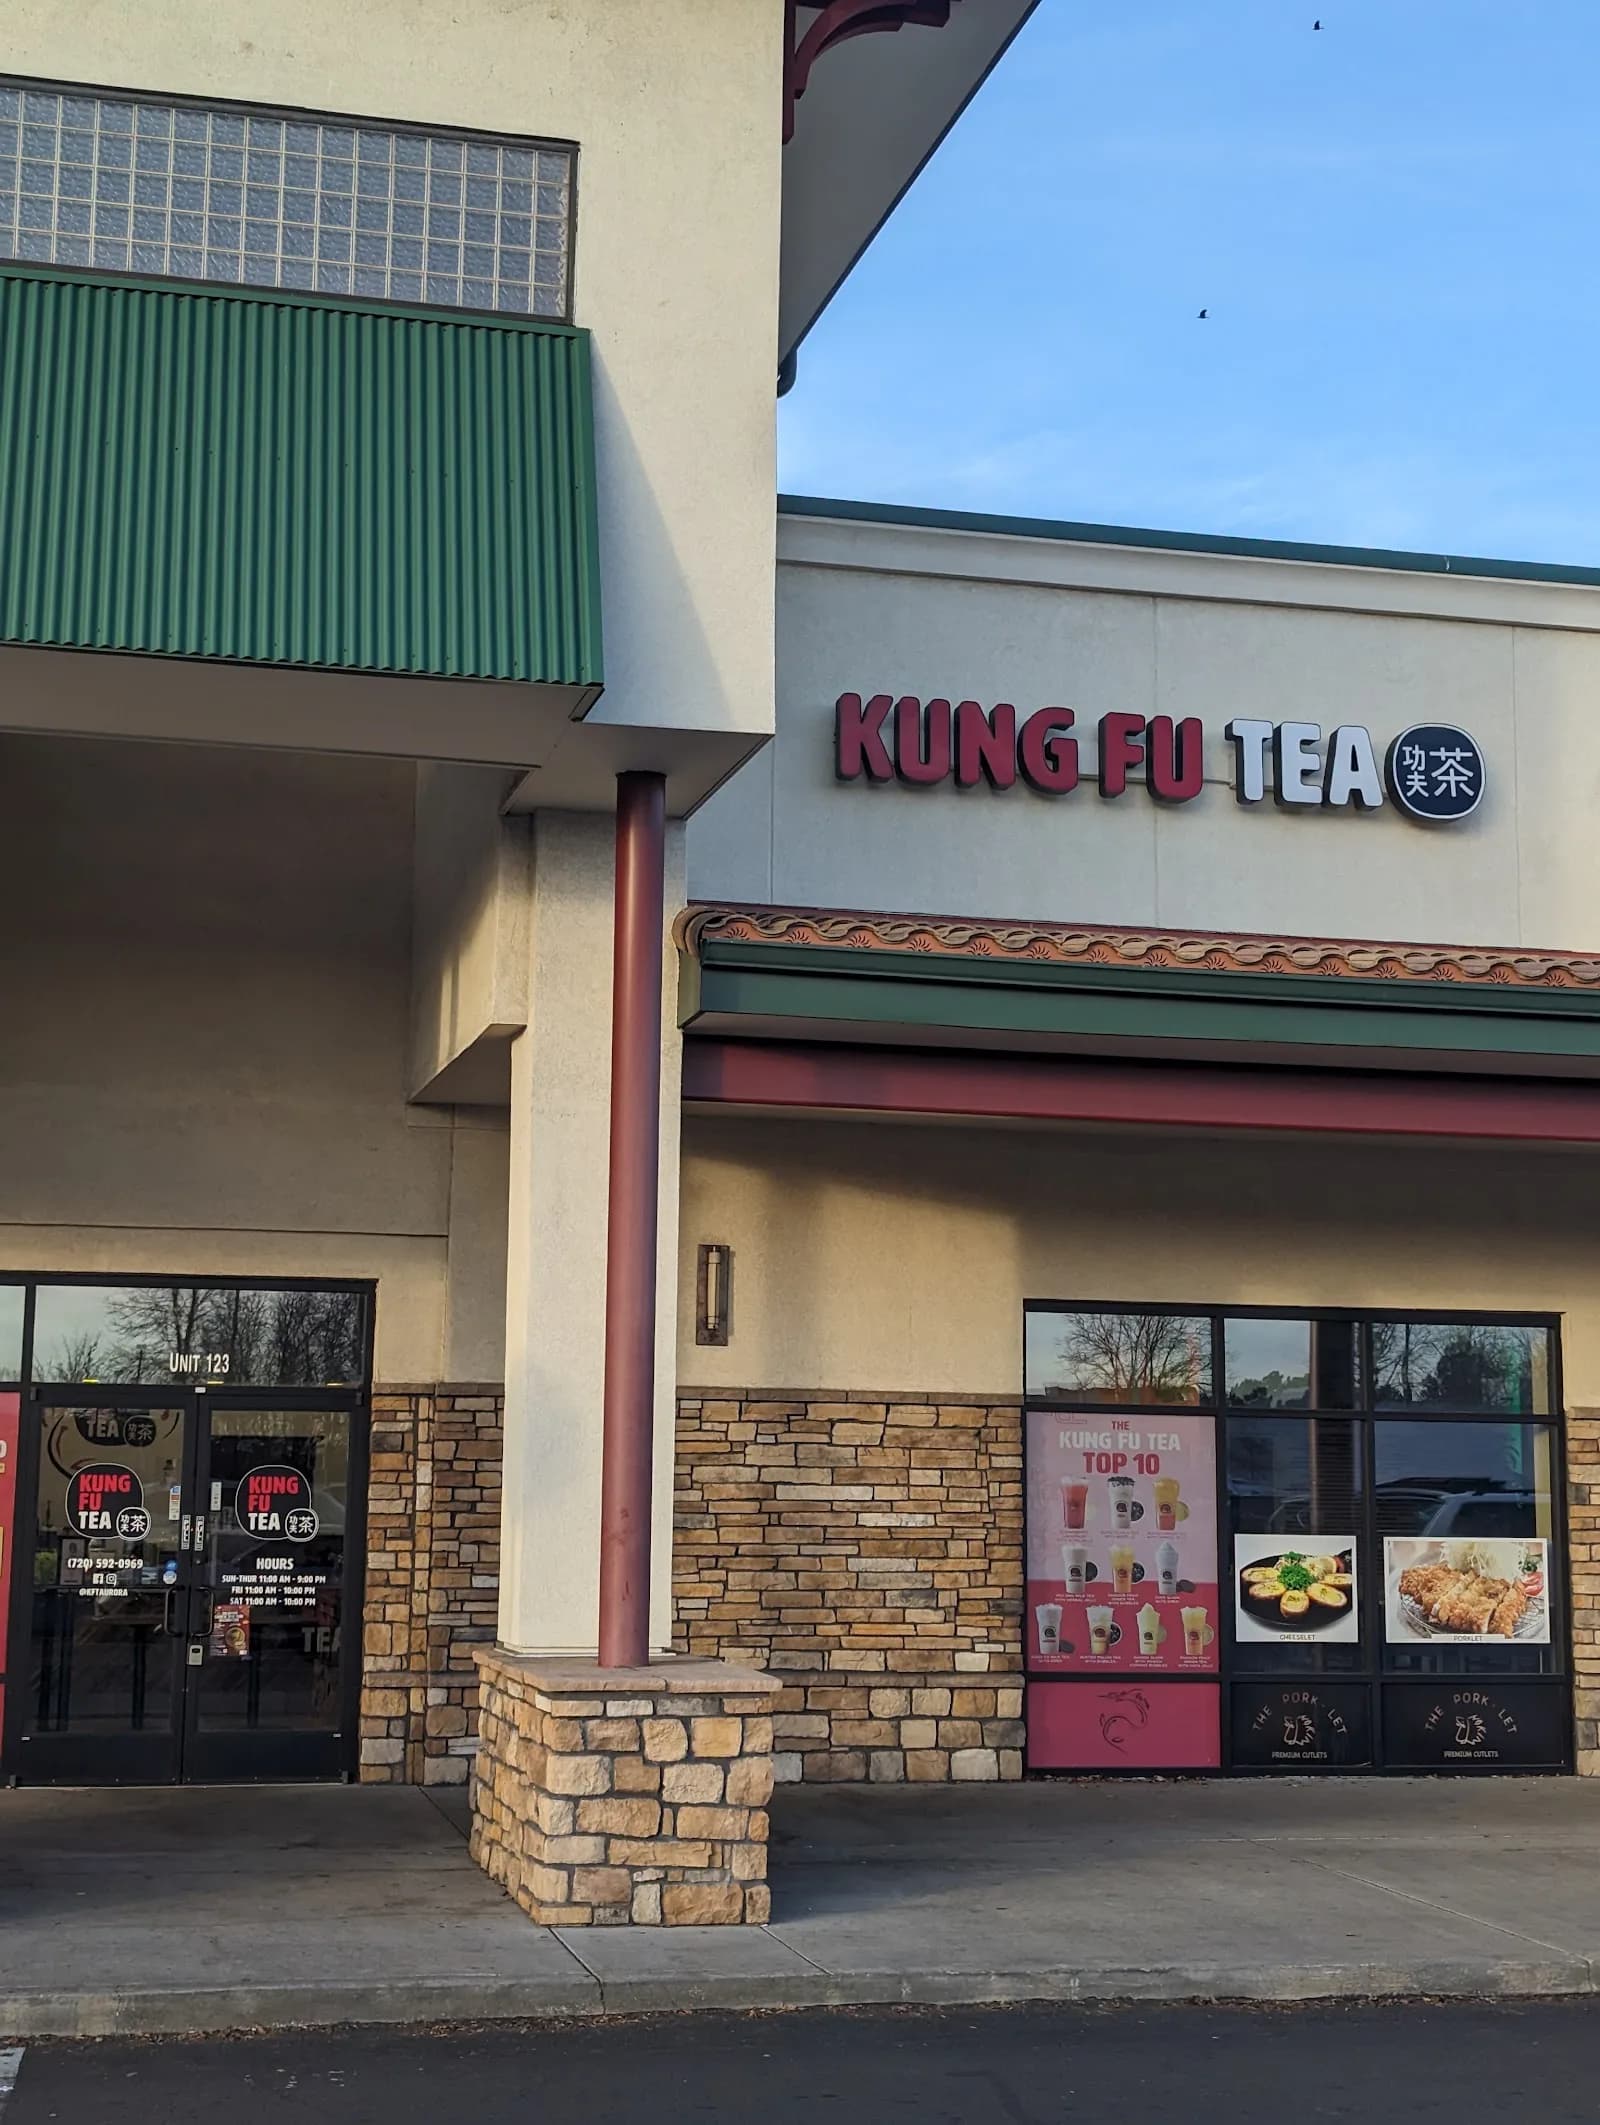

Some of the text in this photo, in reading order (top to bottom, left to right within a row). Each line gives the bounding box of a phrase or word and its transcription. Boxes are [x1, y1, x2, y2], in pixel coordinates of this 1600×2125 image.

[835, 692, 1384, 810] KUNG FU TEA
[169, 1351, 230, 1374] UNIT 123
[86, 1419, 120, 1439] TEA
[1111, 1420, 1130, 1431] THE
[1059, 1431, 1181, 1451] KUNG FU TEA
[1082, 1452, 1160, 1475] TOP 10
[79, 1474, 131, 1493] KUNG
[248, 1475, 299, 1495] KUNG
[78, 1493, 102, 1511] FU
[248, 1494, 271, 1513] FU
[78, 1511, 112, 1530] TEA
[247, 1512, 281, 1531] TEA
[67, 1558, 144, 1569] (720) 592-0969
[256, 1558, 294, 1570] HOURS
[222, 1575, 257, 1583] SUN-THUR
[259, 1575, 278, 1583] 11:00
[279, 1575, 291, 1583] AM
[297, 1575, 314, 1583] 9:00
[315, 1576, 326, 1584] PM
[79, 1588, 128, 1597] @KFTAURORA
[231, 1586, 244, 1594] FRI
[245, 1586, 264, 1594] 11:00
[265, 1586, 277, 1594] AM
[304, 1587, 315, 1595] PM
[230, 1597, 243, 1605] SAT
[304, 1598, 316, 1606] PM
[1253, 1705, 1272, 1731] THE
[1425, 1705, 1444, 1732] THE
[1302, 1751, 1328, 1759] CUTLETS
